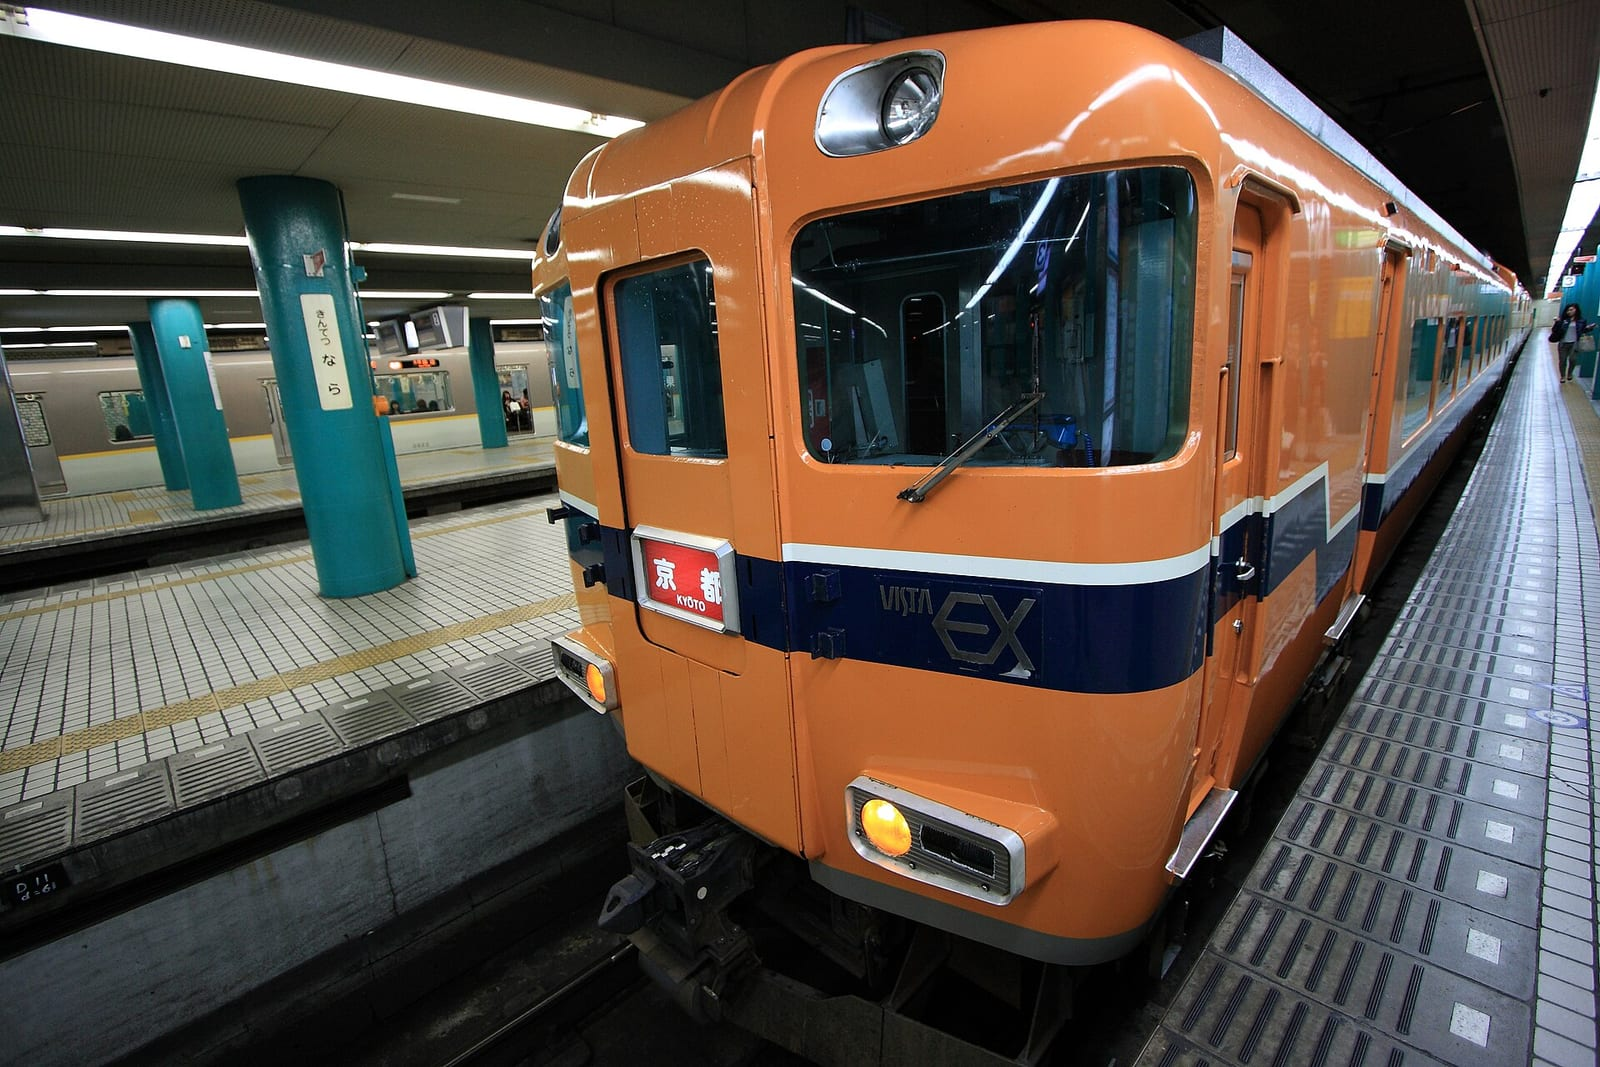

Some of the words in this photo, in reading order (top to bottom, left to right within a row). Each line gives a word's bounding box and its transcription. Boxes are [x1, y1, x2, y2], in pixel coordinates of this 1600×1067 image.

[653, 558, 722, 605] 京都
[879, 584, 933, 617] VISTA
[931, 591, 1037, 671] EX
